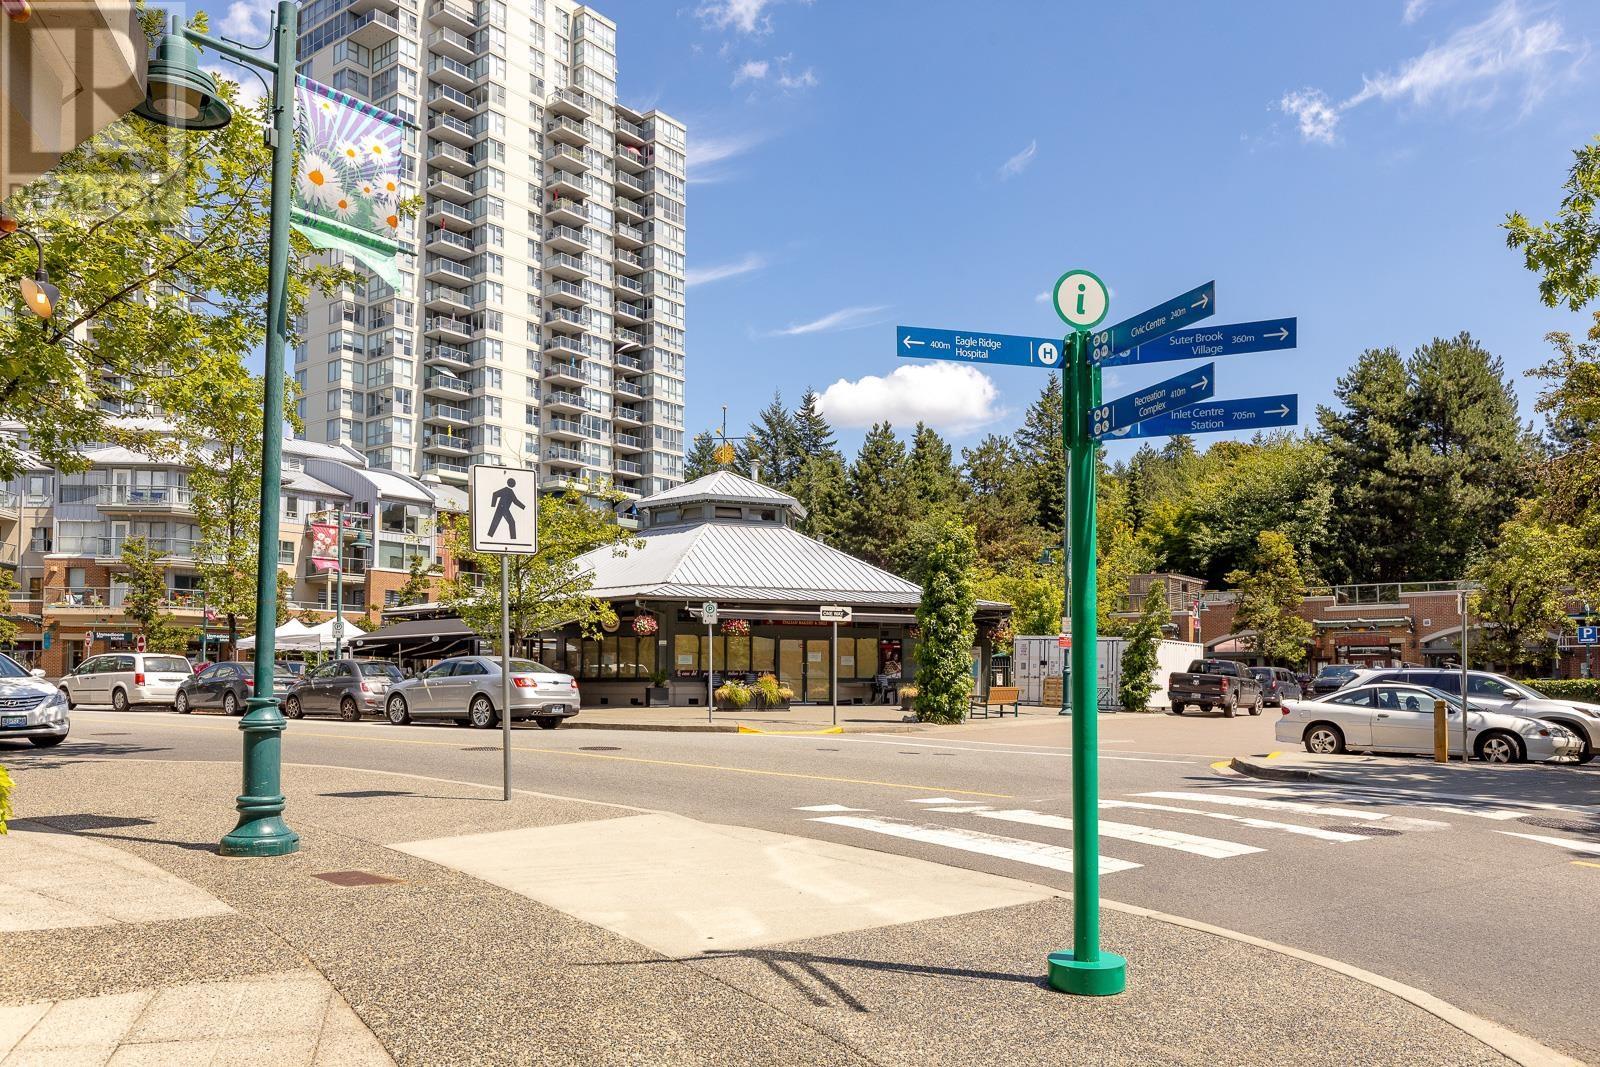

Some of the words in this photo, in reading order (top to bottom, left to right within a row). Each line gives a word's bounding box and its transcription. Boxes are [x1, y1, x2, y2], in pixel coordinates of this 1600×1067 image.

[1170, 307, 1186, 320] 240m
[1131, 322, 1147, 338] Civic
[1146, 316, 1166, 332] Centre
[955, 336, 978, 348] Eagle
[979, 338, 1002, 350] Ridge
[1169, 334, 1194, 346] Suter
[1195, 331, 1224, 343] Brook
[1231, 335, 1255, 344] 360m
[930, 340, 951, 350] 400m
[1191, 344, 1223, 355] Village
[955, 348, 989, 360] Hospital
[1043, 347, 1053, 360] H
[1134, 388, 1166, 406] Recreation
[1170, 388, 1186, 399] 410m
[1138, 402, 1166, 417] Complex
[1171, 409, 1192, 420] Inlet
[1194, 407, 1225, 418] Centre
[1232, 411, 1256, 420] 705m
[1191, 419, 1224, 430] Station
[1583, 628, 1593, 638] P
